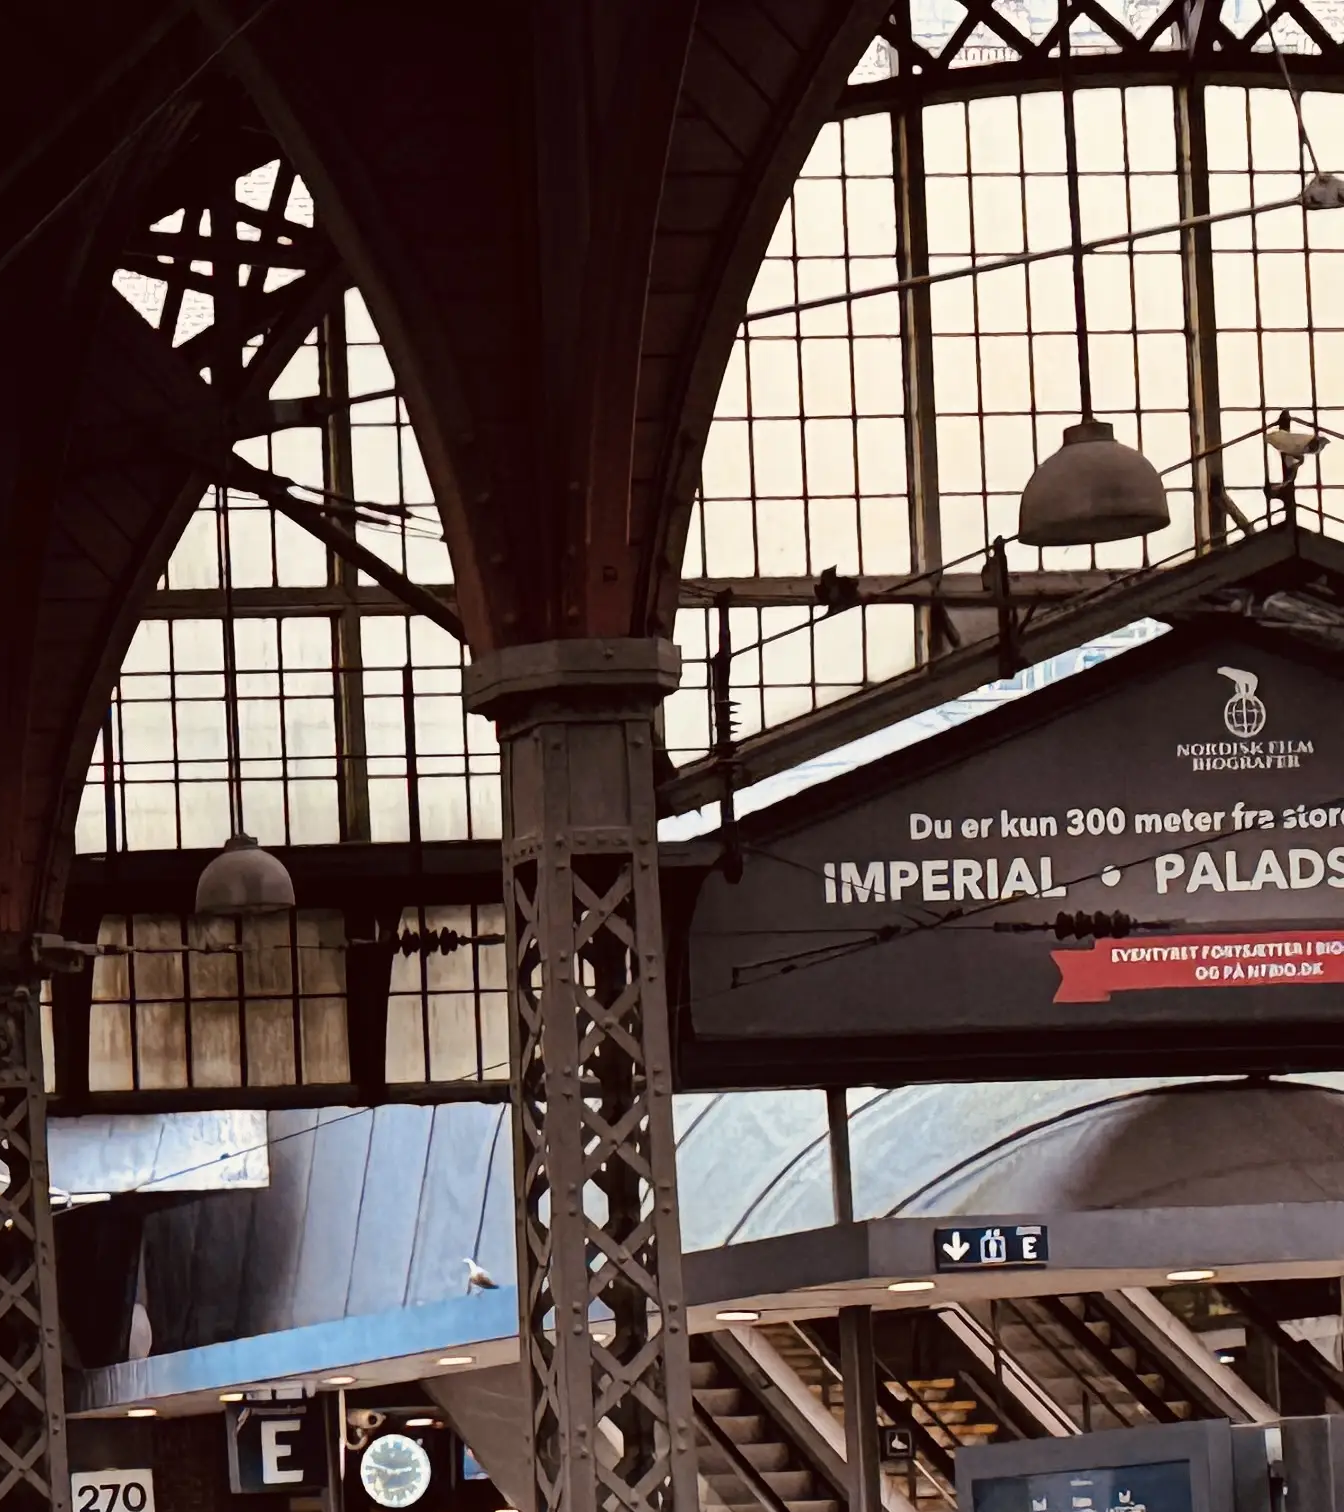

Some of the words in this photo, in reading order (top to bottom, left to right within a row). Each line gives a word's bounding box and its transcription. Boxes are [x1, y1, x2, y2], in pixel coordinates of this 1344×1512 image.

[909, 813, 952, 840] Du
[961, 817, 994, 839] er
[1000, 809, 1058, 838] kun
[1066, 806, 1126, 836] 300
[1134, 807, 1226, 834] meter
[1231, 801, 1275, 832] fra
[1282, 803, 1344, 830] stor
[823, 856, 1068, 904] IMPERIAL
[1022, 1236, 1038, 1260] E
[260, 1419, 305, 1485] E
